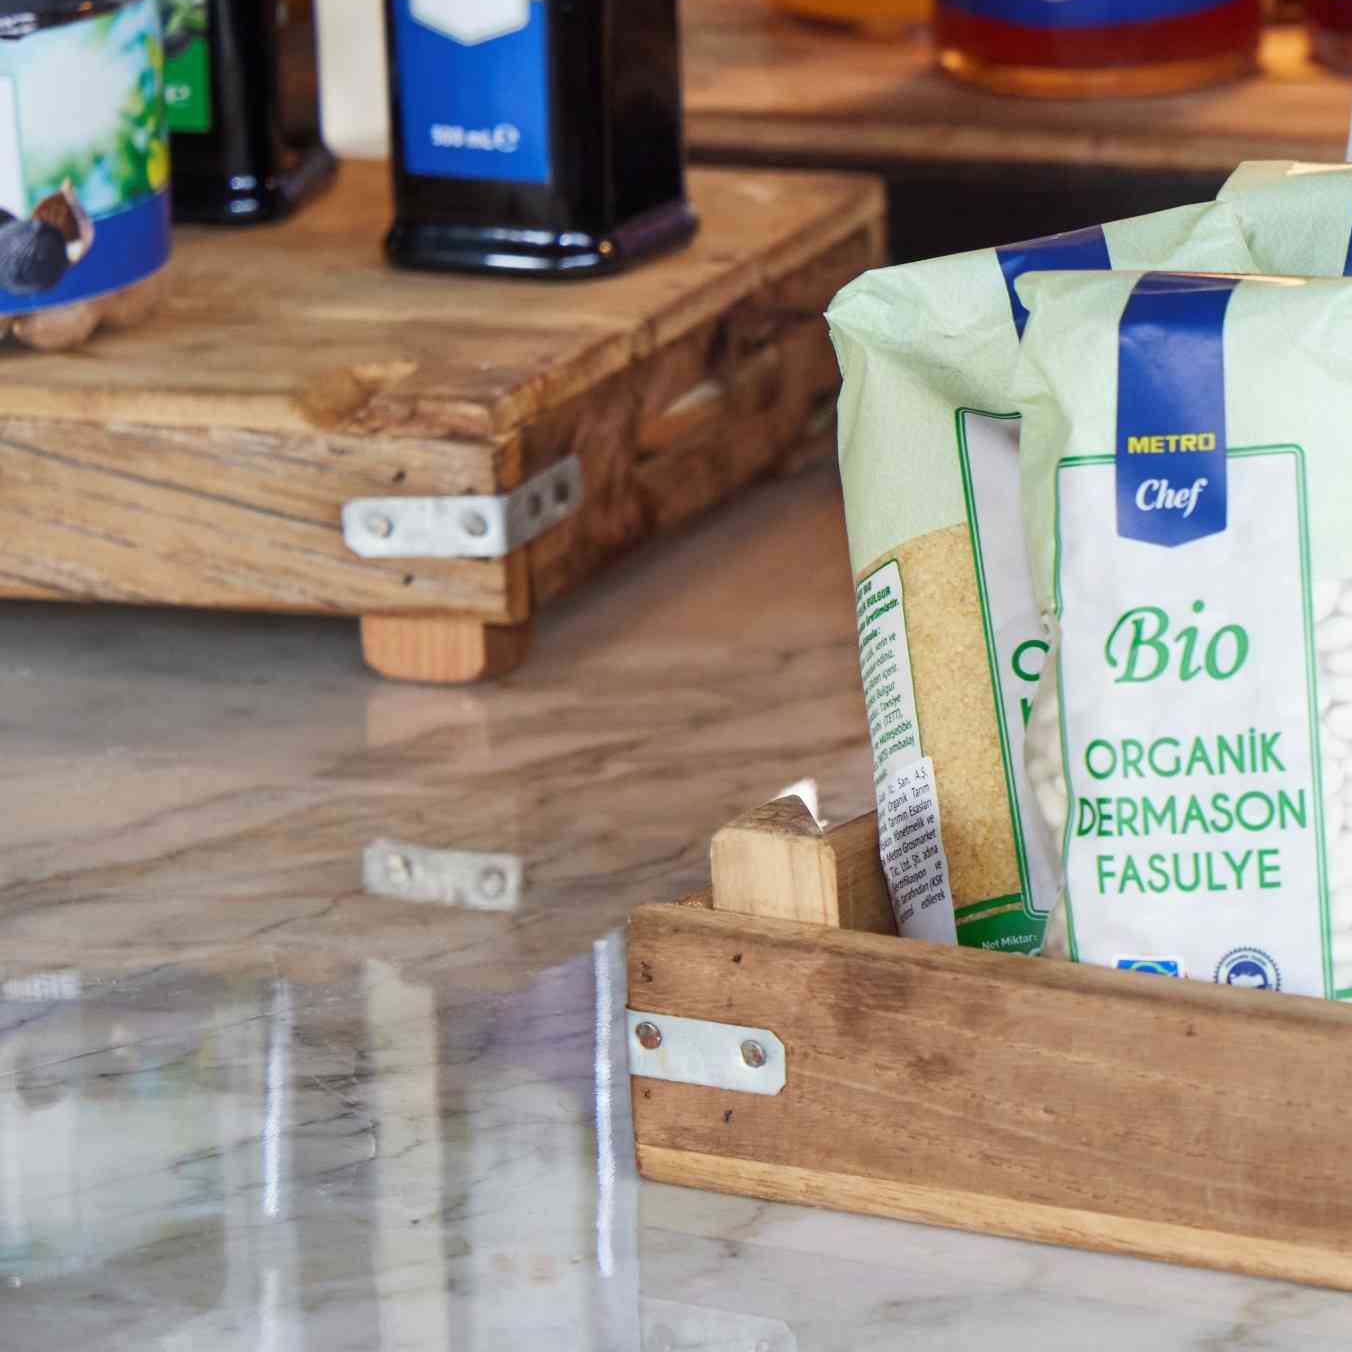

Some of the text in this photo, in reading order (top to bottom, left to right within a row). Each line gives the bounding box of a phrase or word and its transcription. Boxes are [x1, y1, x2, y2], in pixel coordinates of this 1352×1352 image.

[1127, 432, 1216, 455] METRO
[1135, 478, 1207, 518] Chef
[1104, 599, 1250, 686] Bio
[1085, 727, 1287, 780] ORGANİK
[1076, 789, 1308, 838] DERMASON
[1096, 848, 1282, 895] FASULYE
